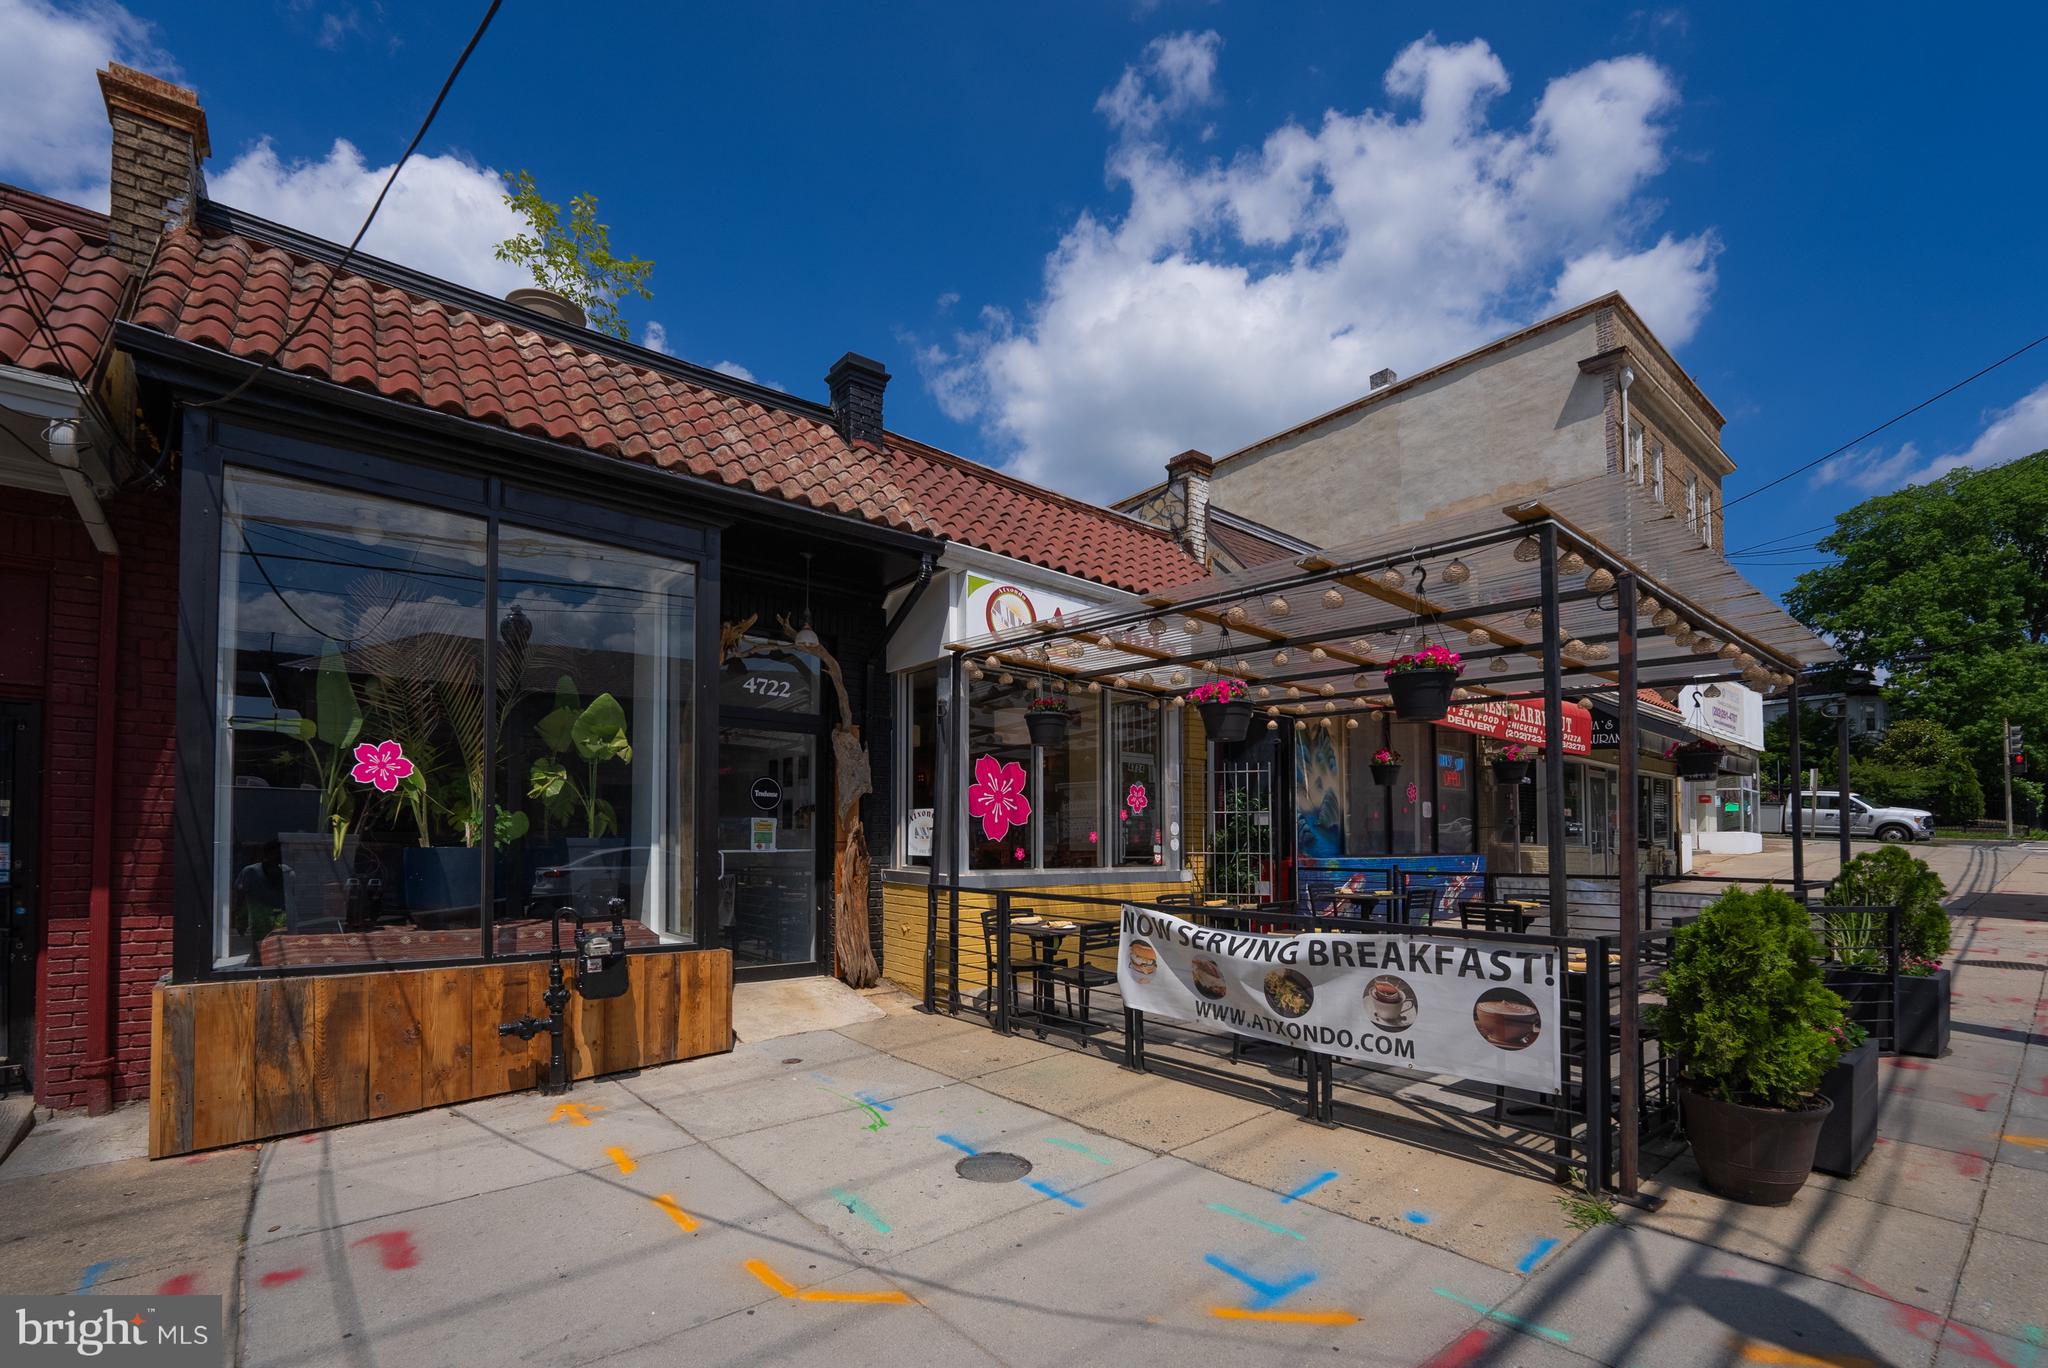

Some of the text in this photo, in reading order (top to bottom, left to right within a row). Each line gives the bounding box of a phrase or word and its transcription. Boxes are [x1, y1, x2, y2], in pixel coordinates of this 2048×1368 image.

[743, 677, 791, 697] 4722
[1447, 714, 1496, 733] DELIVERY
[1458, 708, 1582, 743] SEA FOOD CHICKEN PIZZA
[1123, 910, 1555, 987] NOW SERVING BREAKFAST!
[1195, 1000, 1415, 1060] WWW.ATXONDO.COM
